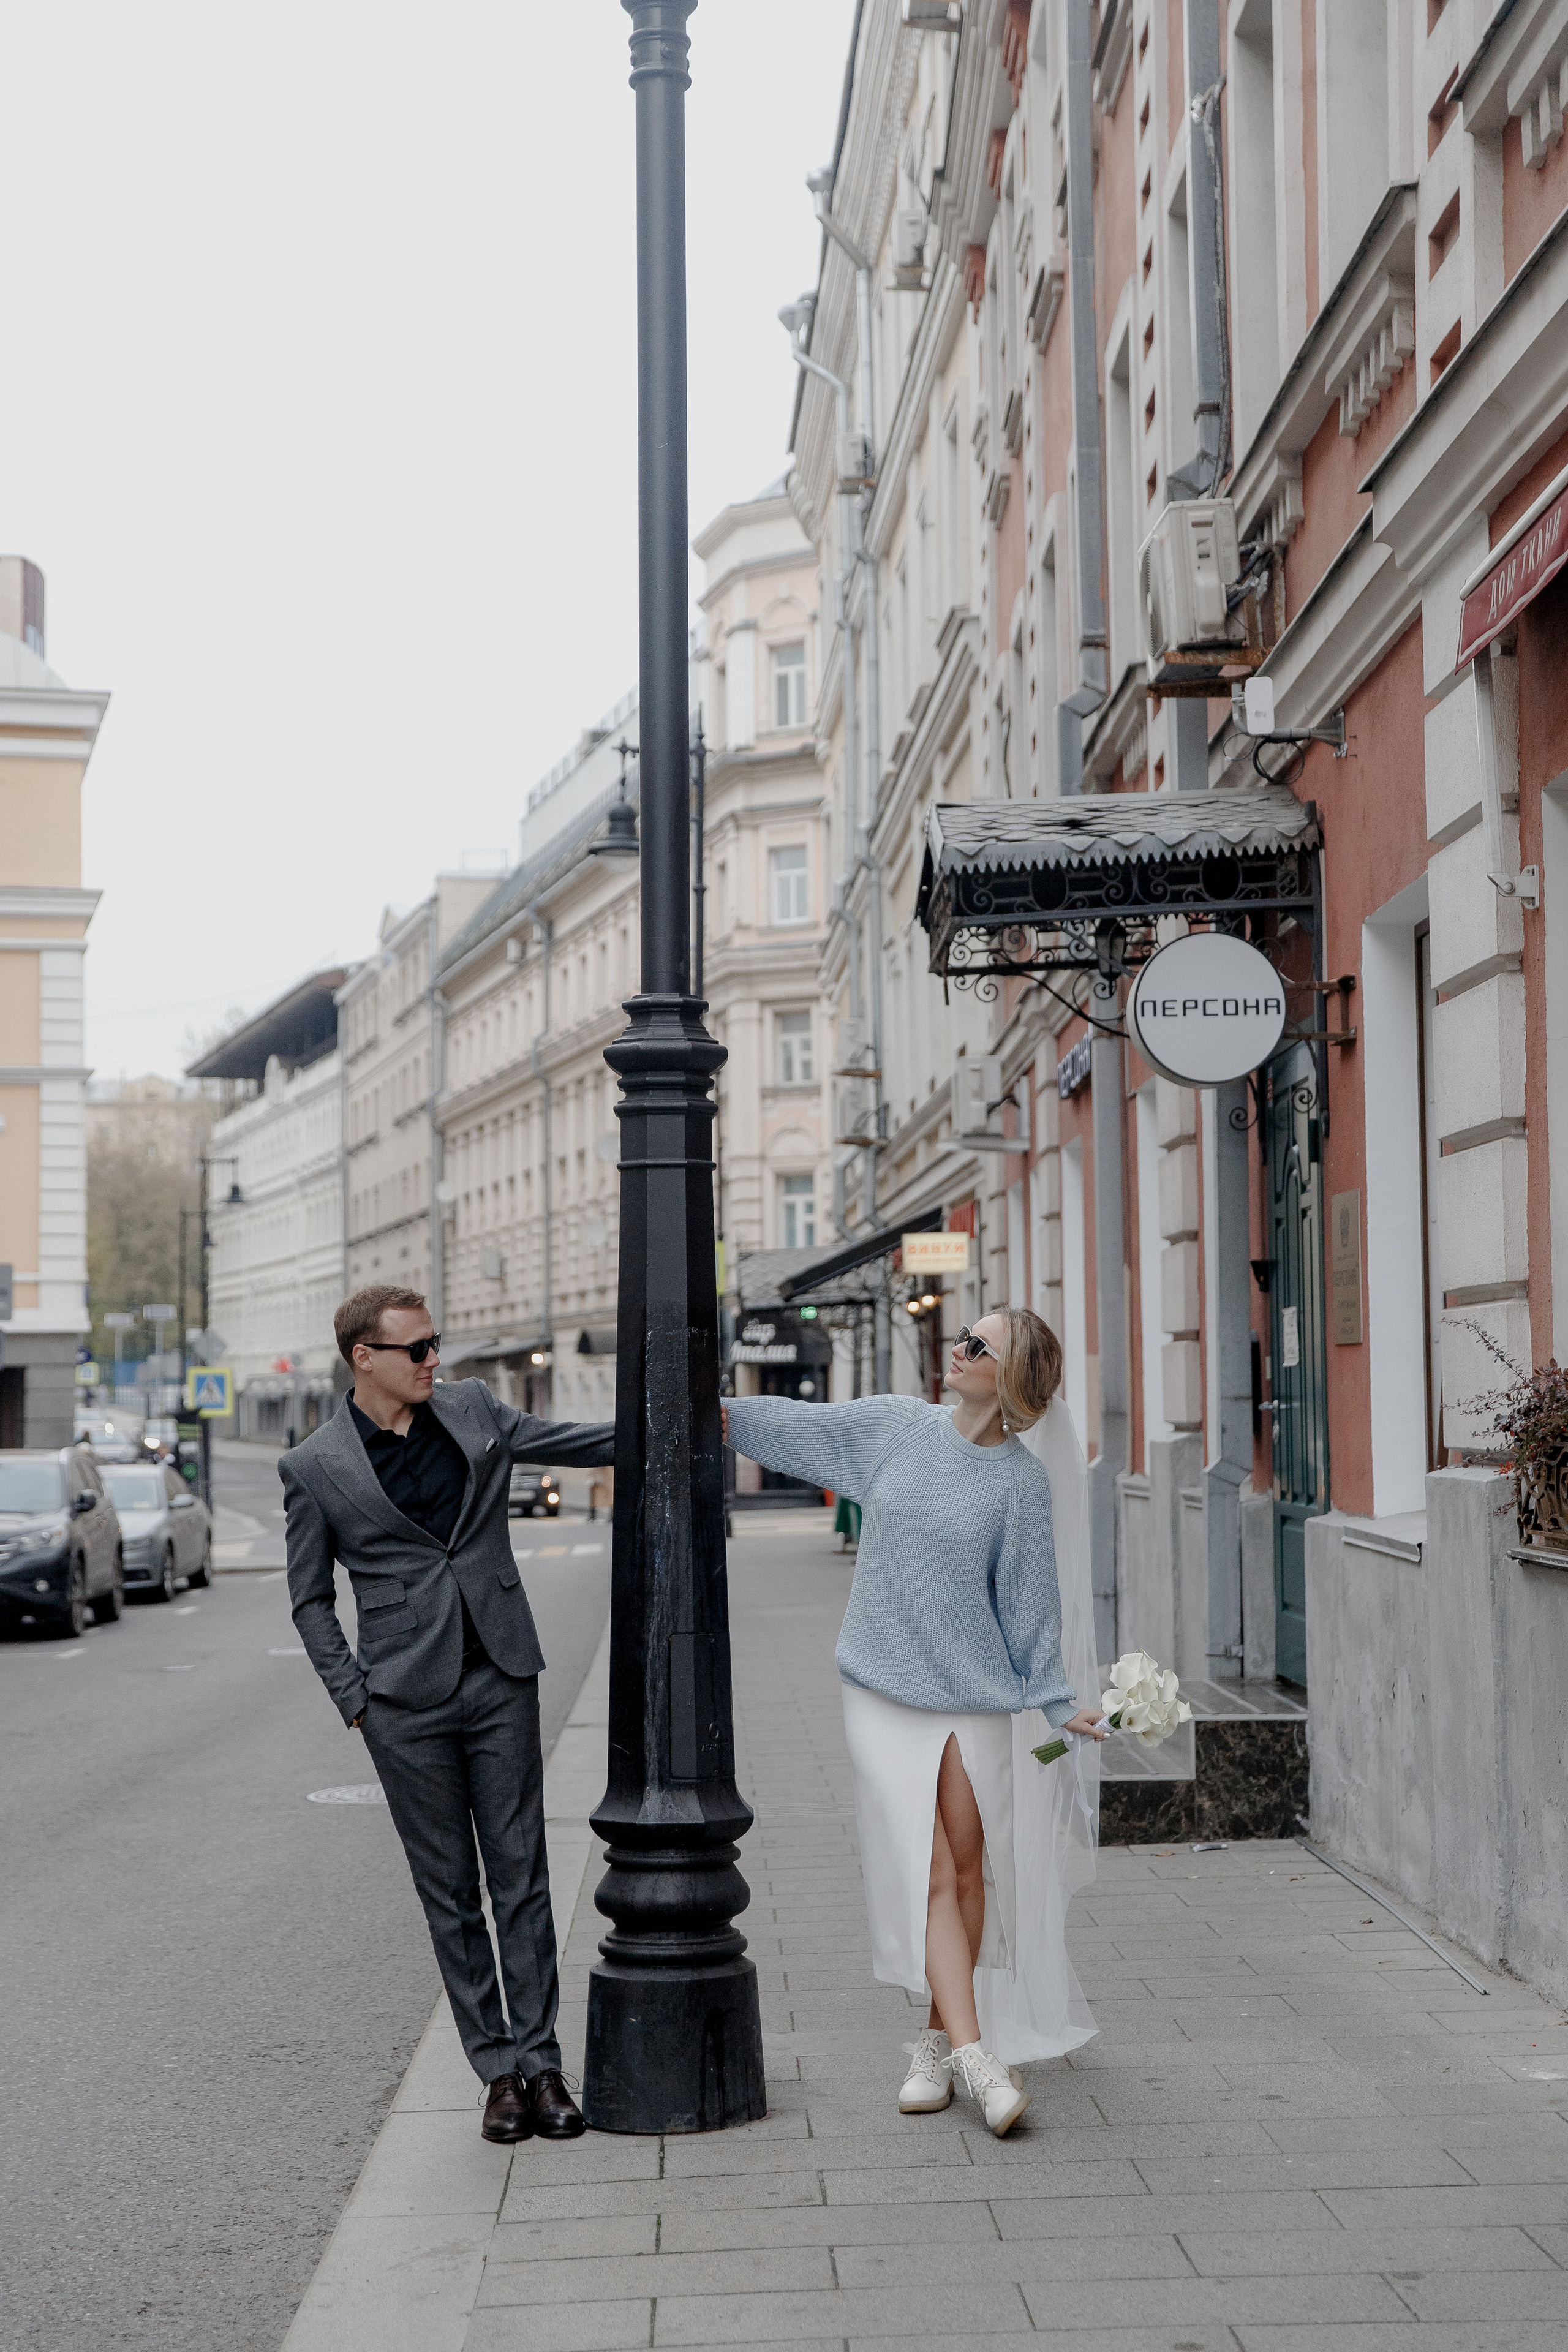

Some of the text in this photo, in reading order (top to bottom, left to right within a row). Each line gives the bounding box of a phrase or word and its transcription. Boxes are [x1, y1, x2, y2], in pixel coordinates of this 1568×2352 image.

[1486, 506, 1562, 624] ДОМ ТКАНИ
[1140, 998, 1281, 1017] ПЕРСОНА
